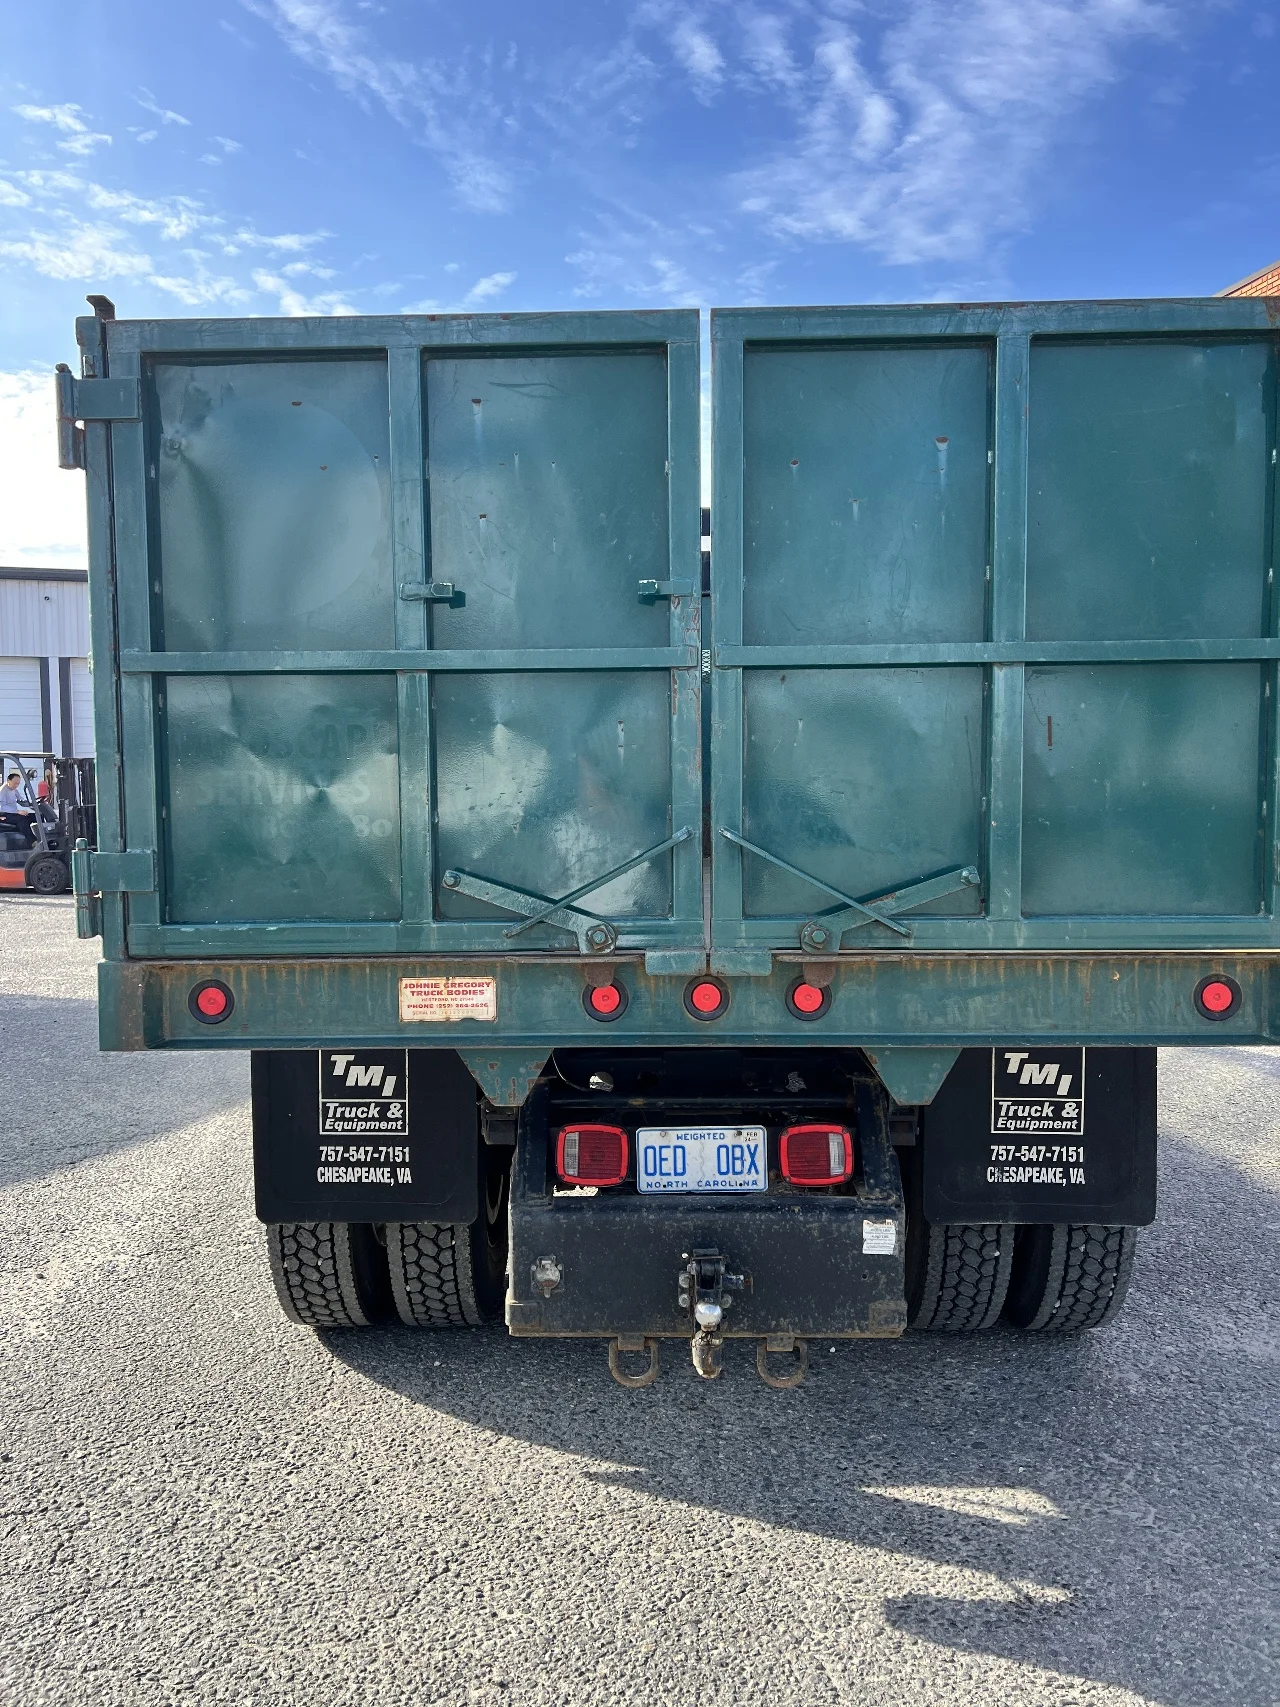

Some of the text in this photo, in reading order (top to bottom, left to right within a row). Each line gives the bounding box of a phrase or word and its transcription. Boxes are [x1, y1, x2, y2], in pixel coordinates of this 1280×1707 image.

[330, 1055, 397, 1096] TMI
[1004, 1053, 1073, 1095] TMI
[325, 1103, 404, 1118] Truck &
[998, 1102, 1080, 1118] Truck &
[324, 1118, 404, 1131] Equipment
[997, 1117, 1078, 1130] Equipment
[677, 1133, 725, 1141] WEIGHTED
[320, 1146, 410, 1162] 757-547-7151
[990, 1146, 1084, 1163] 757-547-7151
[317, 1167, 412, 1186] CHESAPEAKE, VA
[697, 1180, 758, 1188] CAROLINA
[1069, 1168, 1085, 1184] VA
